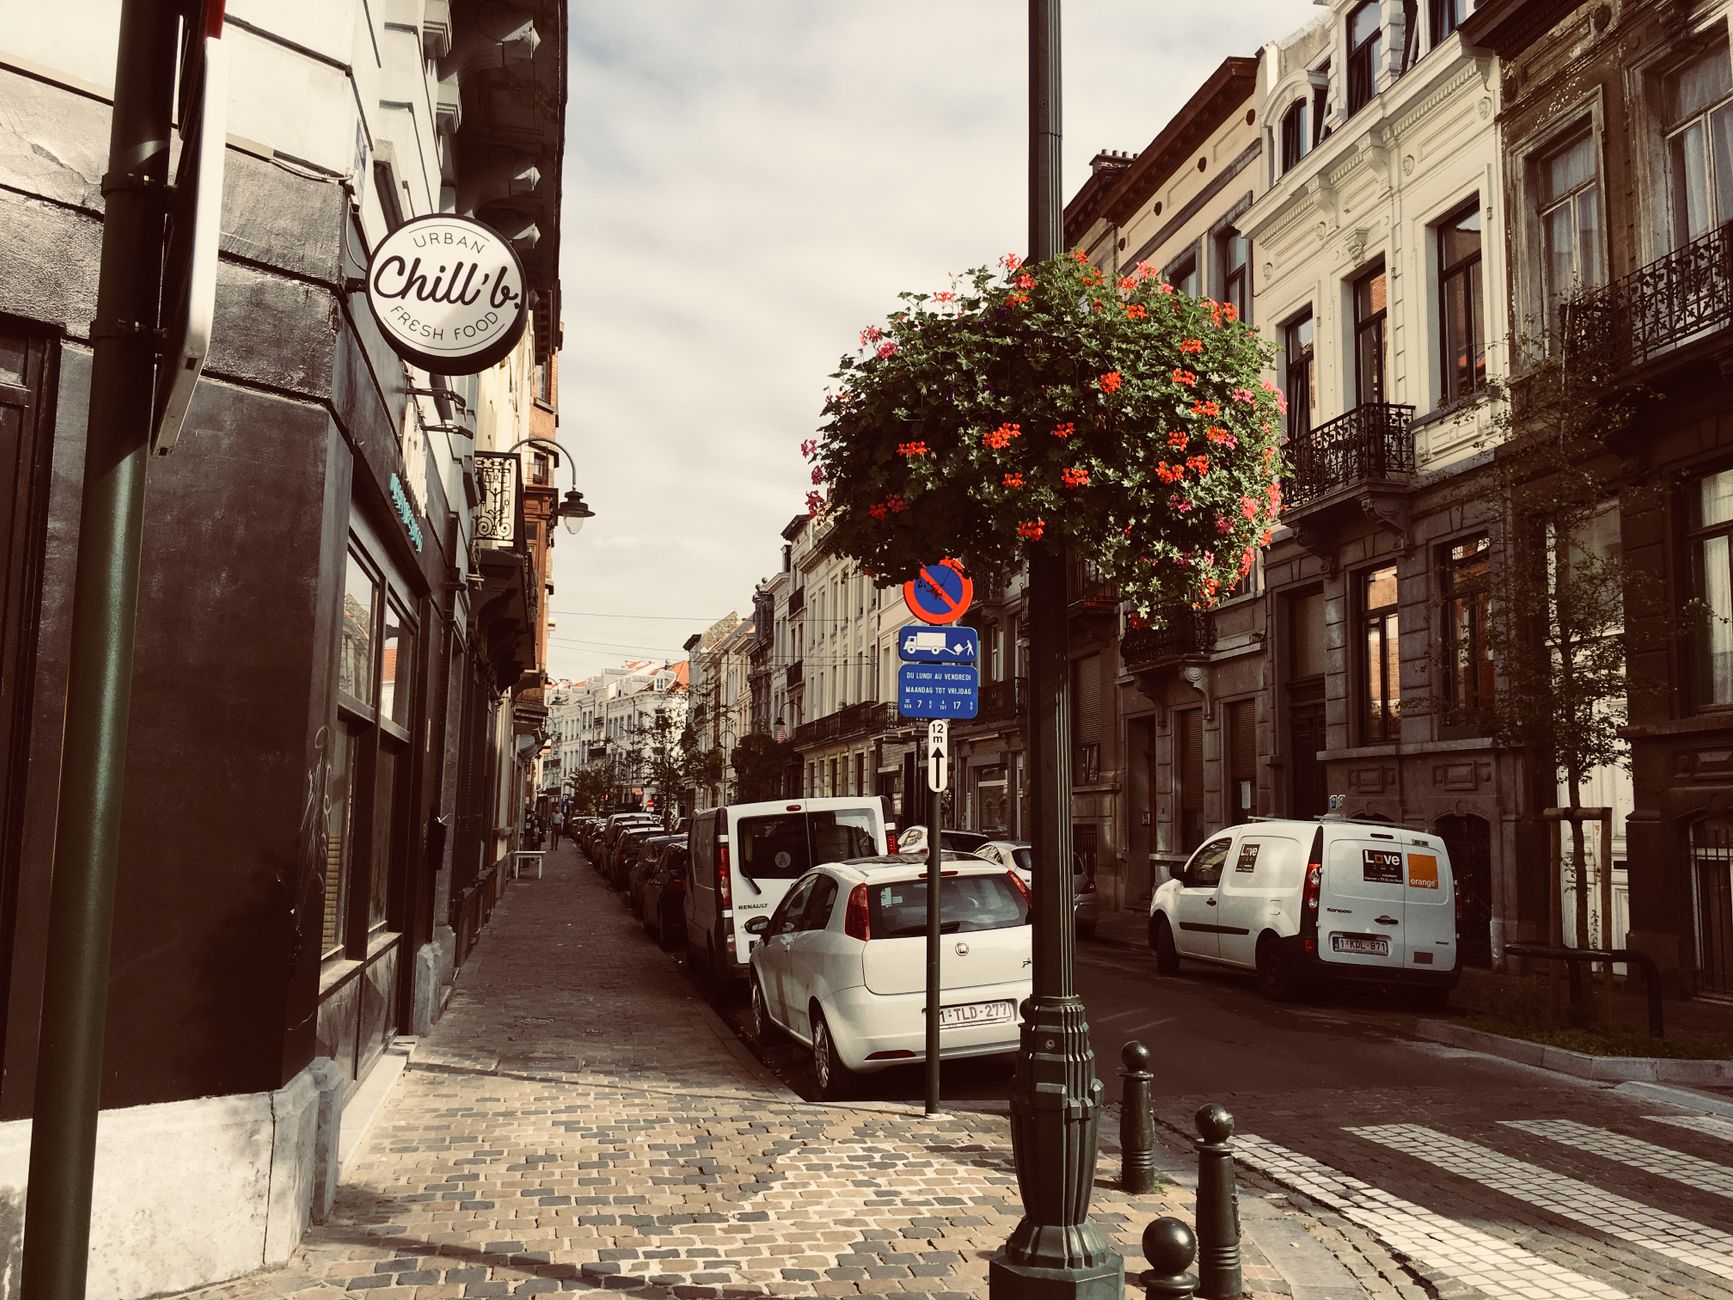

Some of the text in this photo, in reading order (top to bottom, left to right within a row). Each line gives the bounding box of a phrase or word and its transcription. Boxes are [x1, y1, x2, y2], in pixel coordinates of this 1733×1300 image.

[413, 232, 486, 254] URBAN
[390, 305, 499, 341] FRESH FOOD
[944, 673, 972, 681] VENDREDI
[905, 686, 933, 694] MAANDAG
[917, 700, 922, 709] 7
[953, 701, 961, 710] 17
[932, 724, 944, 734] 12
[1410, 878, 1437, 888] orange
